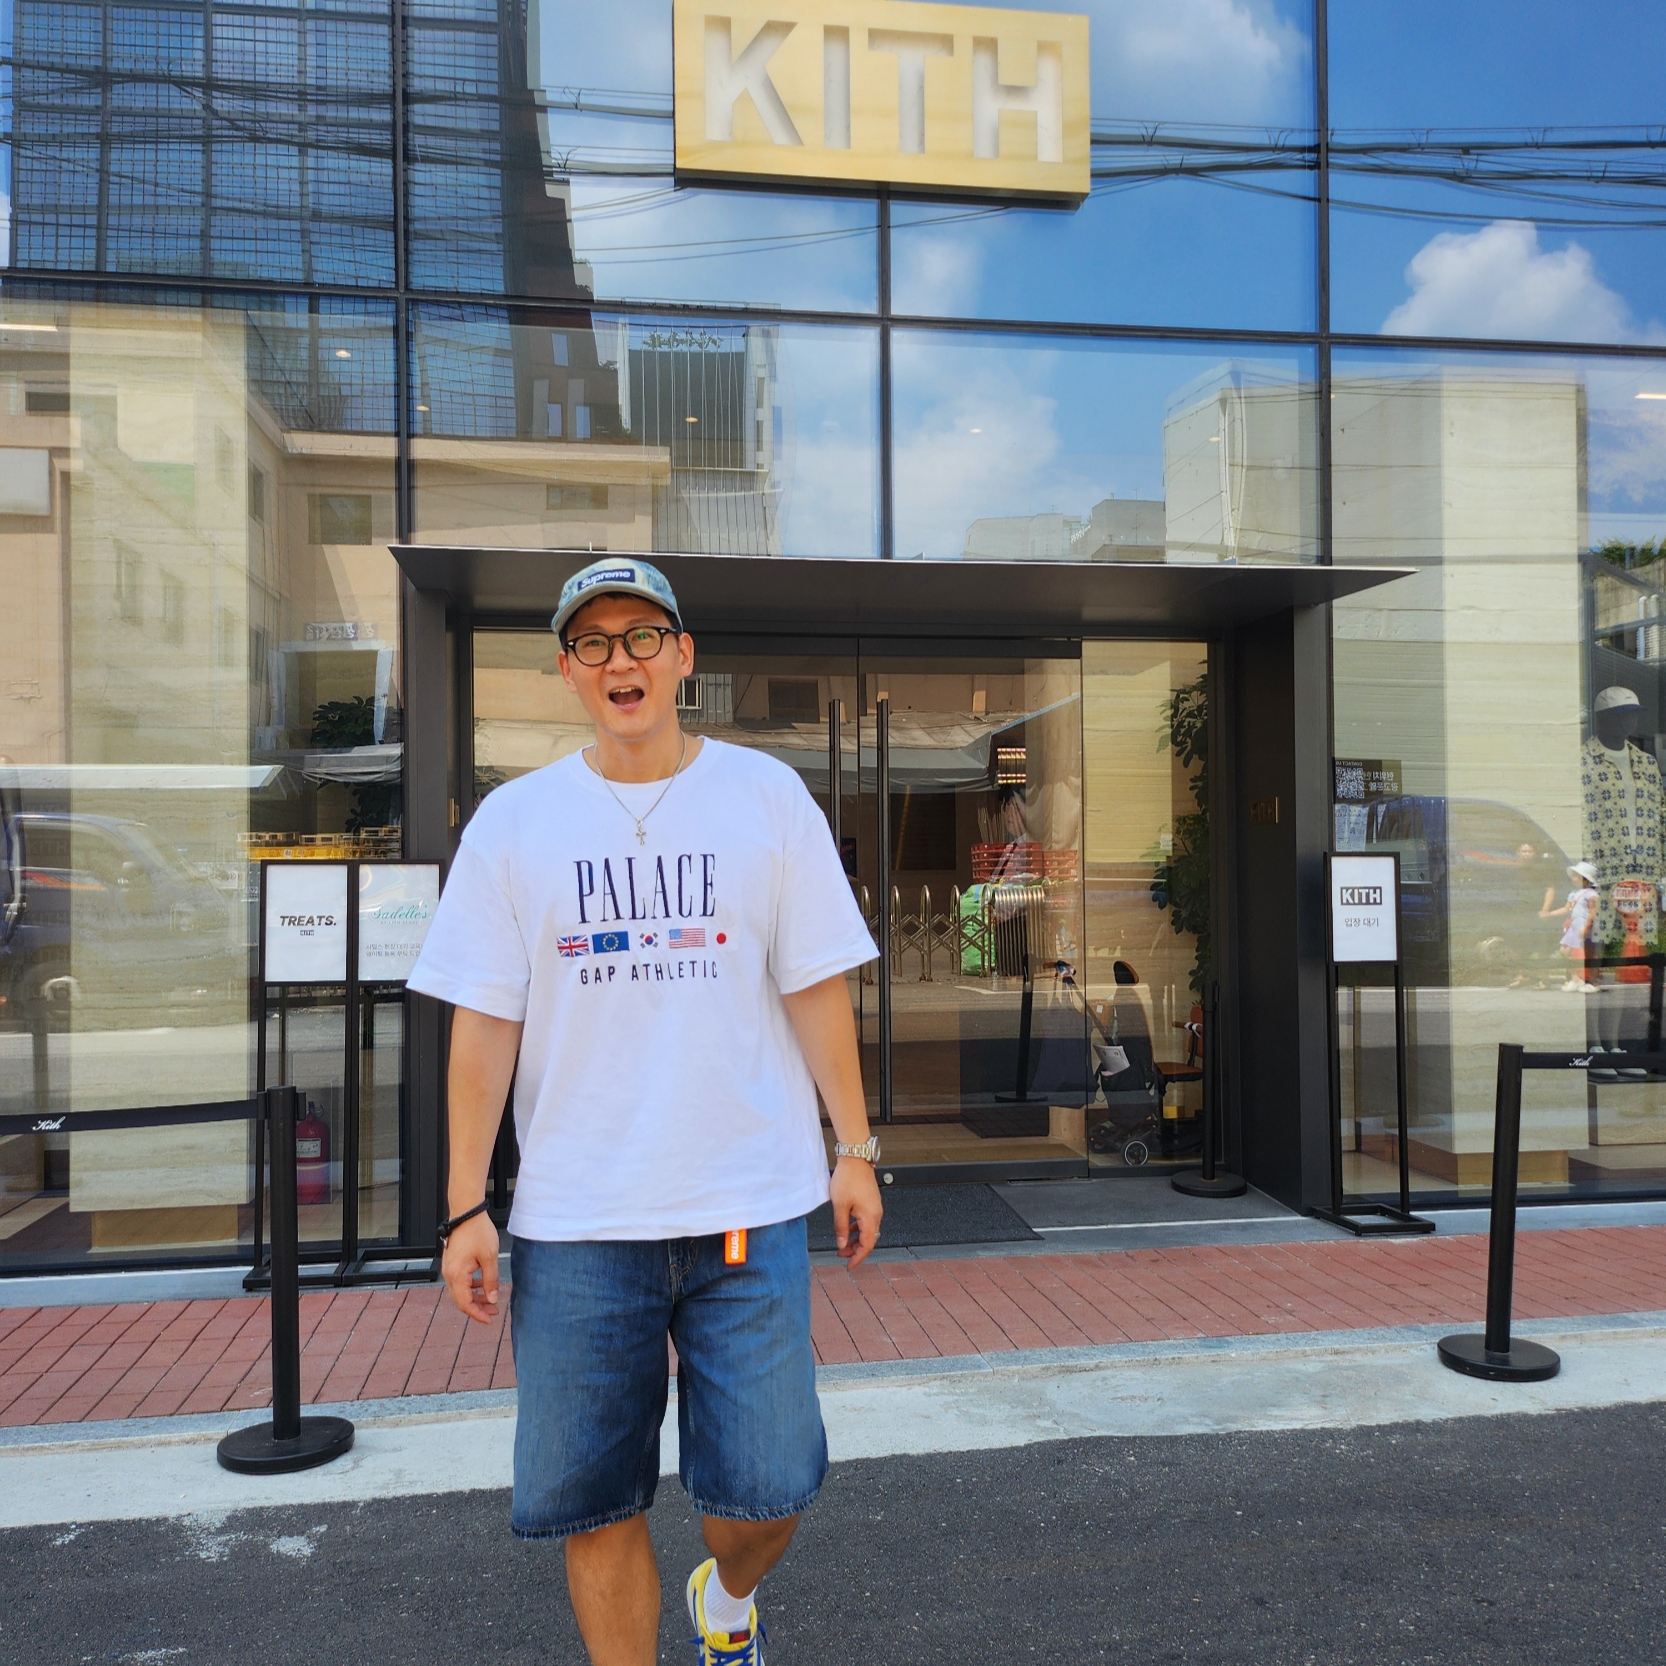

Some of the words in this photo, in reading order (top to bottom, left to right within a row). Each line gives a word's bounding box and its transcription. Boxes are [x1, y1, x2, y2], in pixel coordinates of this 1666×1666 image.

[704, 14, 1063, 163] KITH
[581, 570, 631, 588] Supreme
[573, 853, 716, 924] PALACE
[1342, 888, 1381, 904] KITH
[280, 915, 337, 927] TREATS.
[1345, 917, 1361, 927] 입장
[1363, 917, 1379, 927] 대기
[580, 965, 616, 985] GAP
[631, 960, 718, 982] ATHLETIC
[1568, 1056, 1594, 1067] Kith
[32, 1116, 67, 1131] Kith
[731, 1230, 739, 1260] reme
